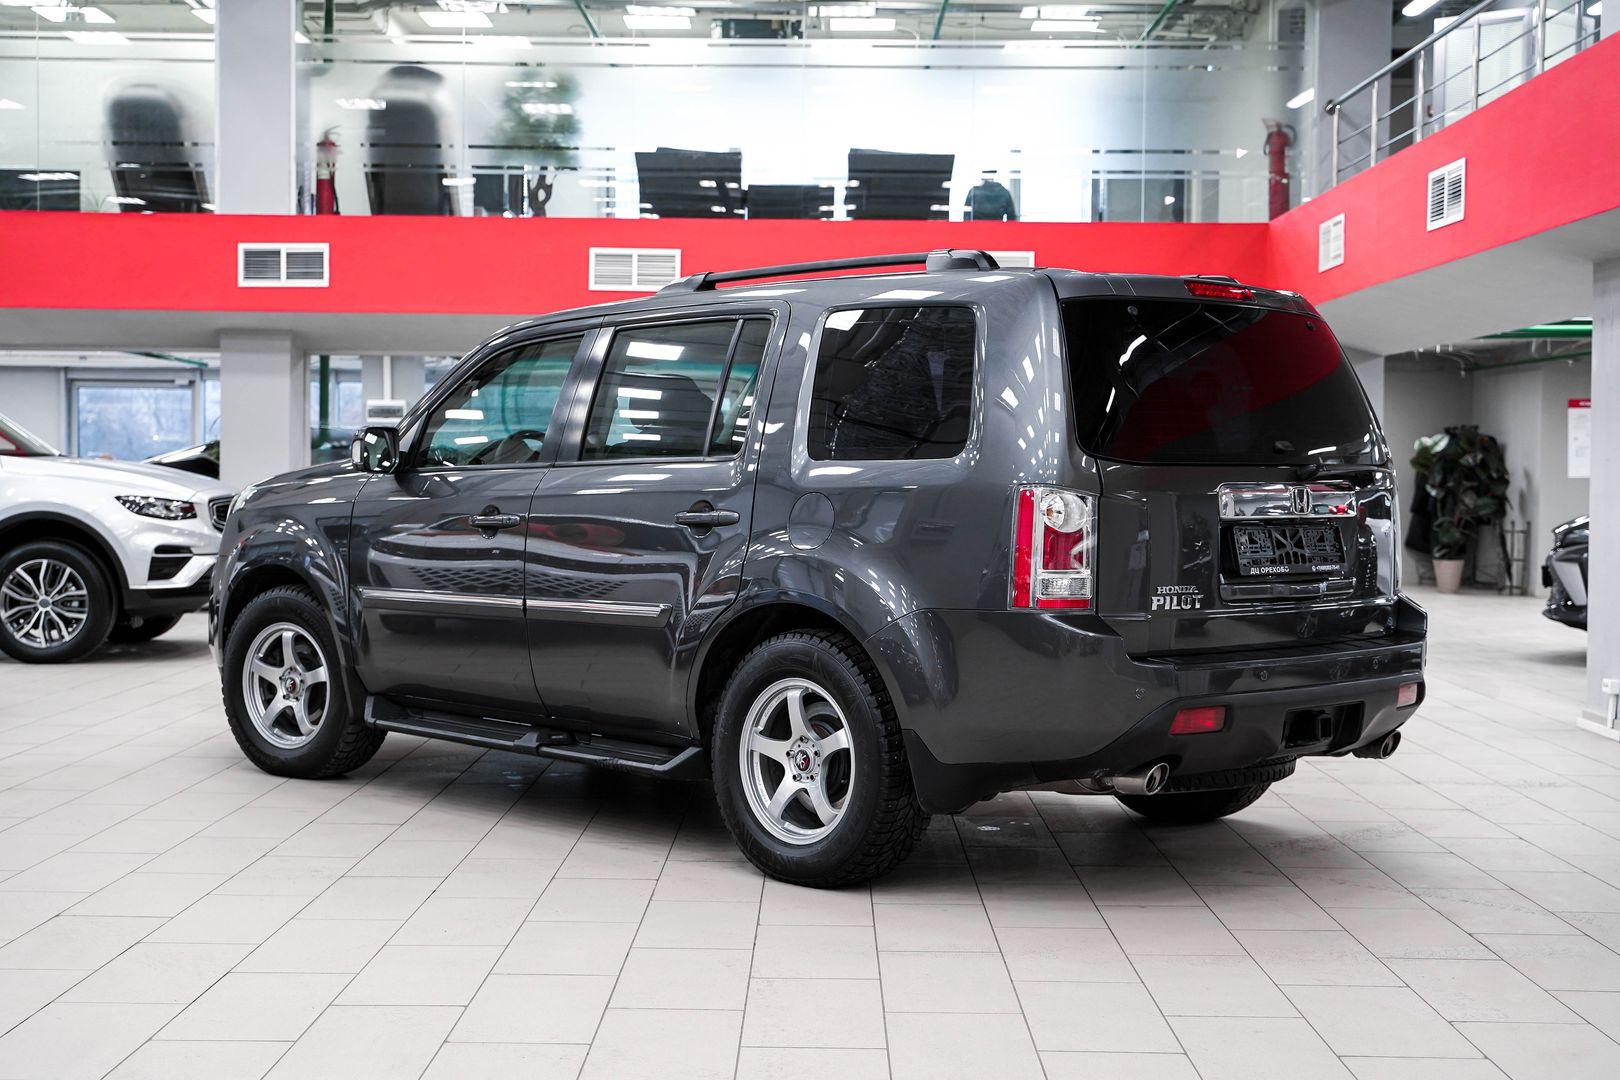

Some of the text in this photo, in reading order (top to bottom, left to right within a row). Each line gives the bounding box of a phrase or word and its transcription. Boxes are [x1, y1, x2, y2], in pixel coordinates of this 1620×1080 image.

[1250, 567, 1260, 575] ДЦ
[1156, 585, 1199, 594] HONDA
[1151, 594, 1204, 611] PILOT
